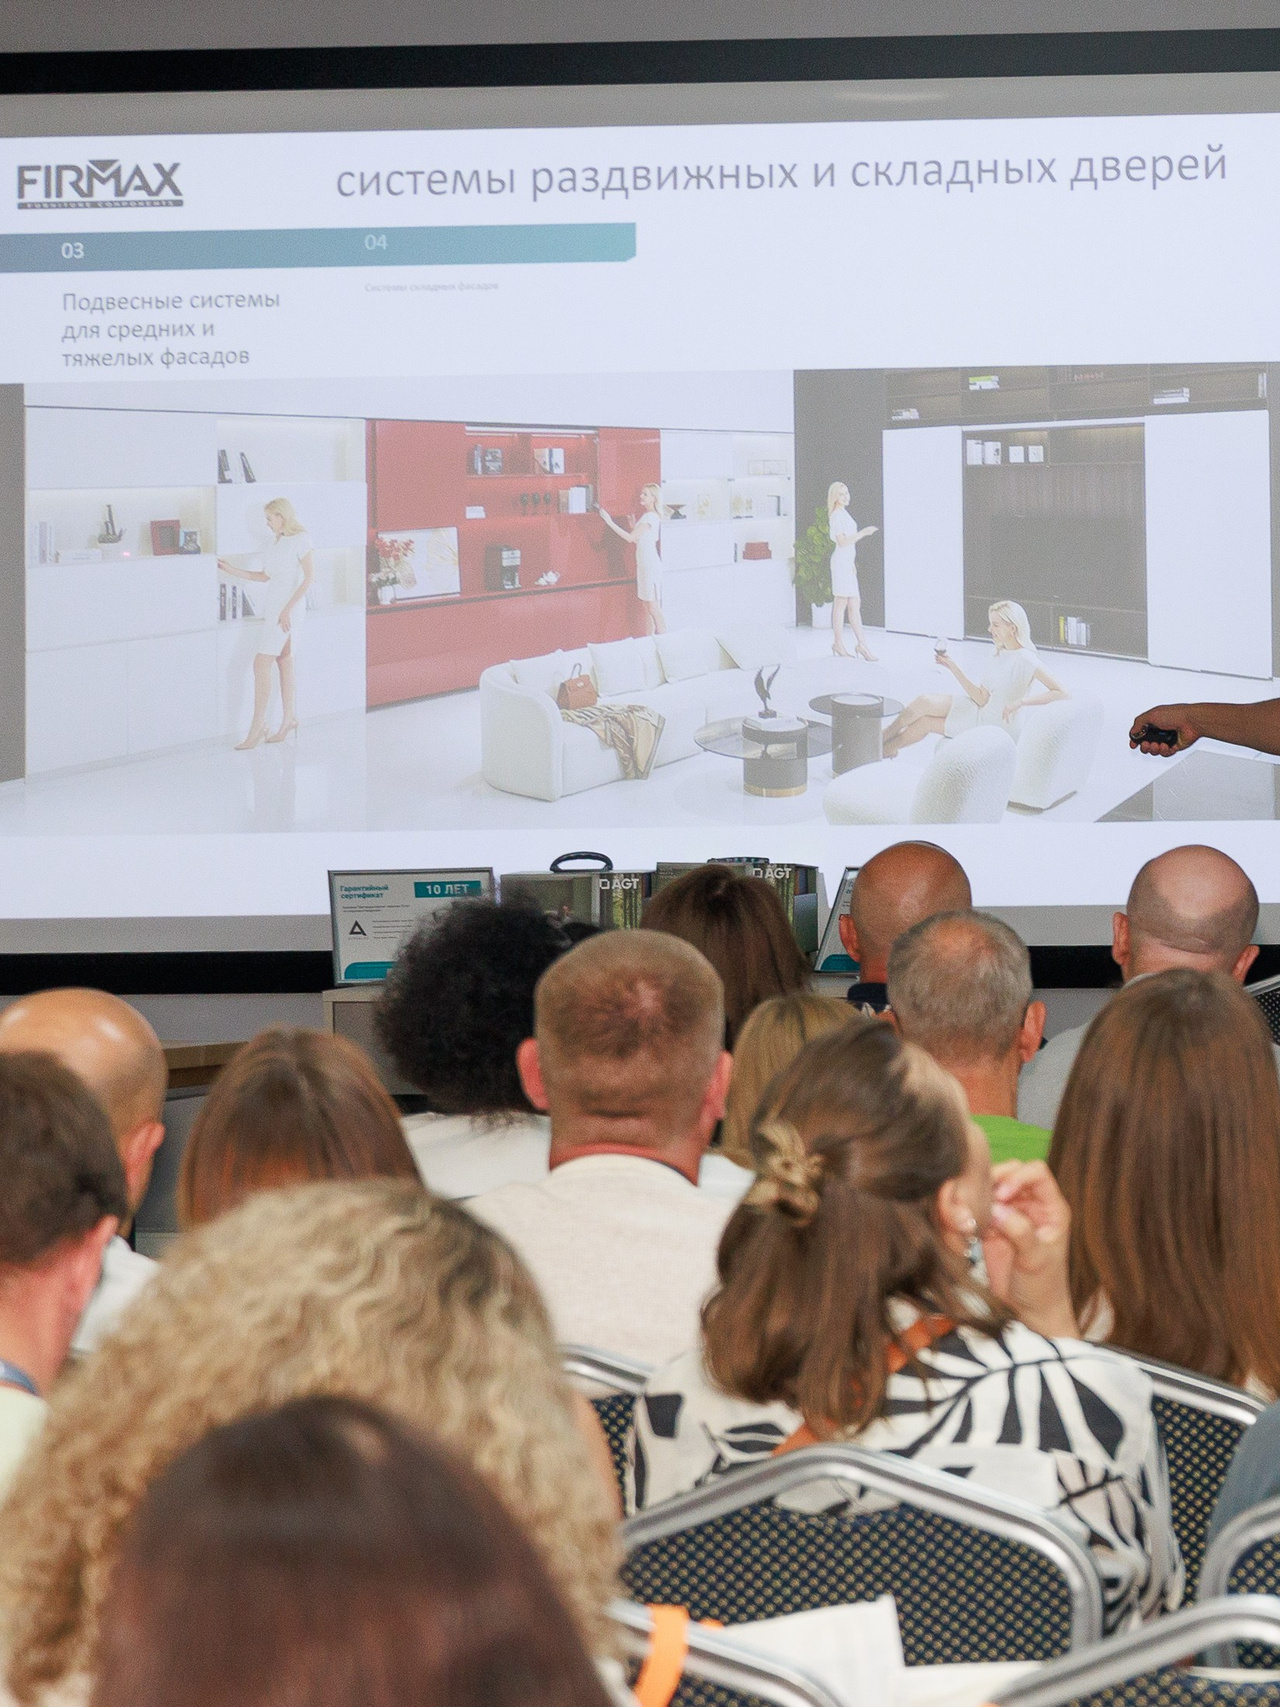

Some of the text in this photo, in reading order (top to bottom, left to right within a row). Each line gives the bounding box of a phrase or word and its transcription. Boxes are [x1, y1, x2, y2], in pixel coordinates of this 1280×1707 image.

[17, 158, 184, 200] FIRMAX
[336, 143, 1227, 203] системы раздвижных и складных дверей
[61, 241, 85, 259] 03
[364, 233, 388, 250] 04
[62, 292, 281, 315] Подвесные системы
[61, 322, 215, 343] для средних и
[61, 346, 250, 369] тяжелых фасадов
[764, 867, 793, 879] AGT
[426, 883, 470, 895] 10 ЛЕТ
[611, 878, 640, 890] AGT
